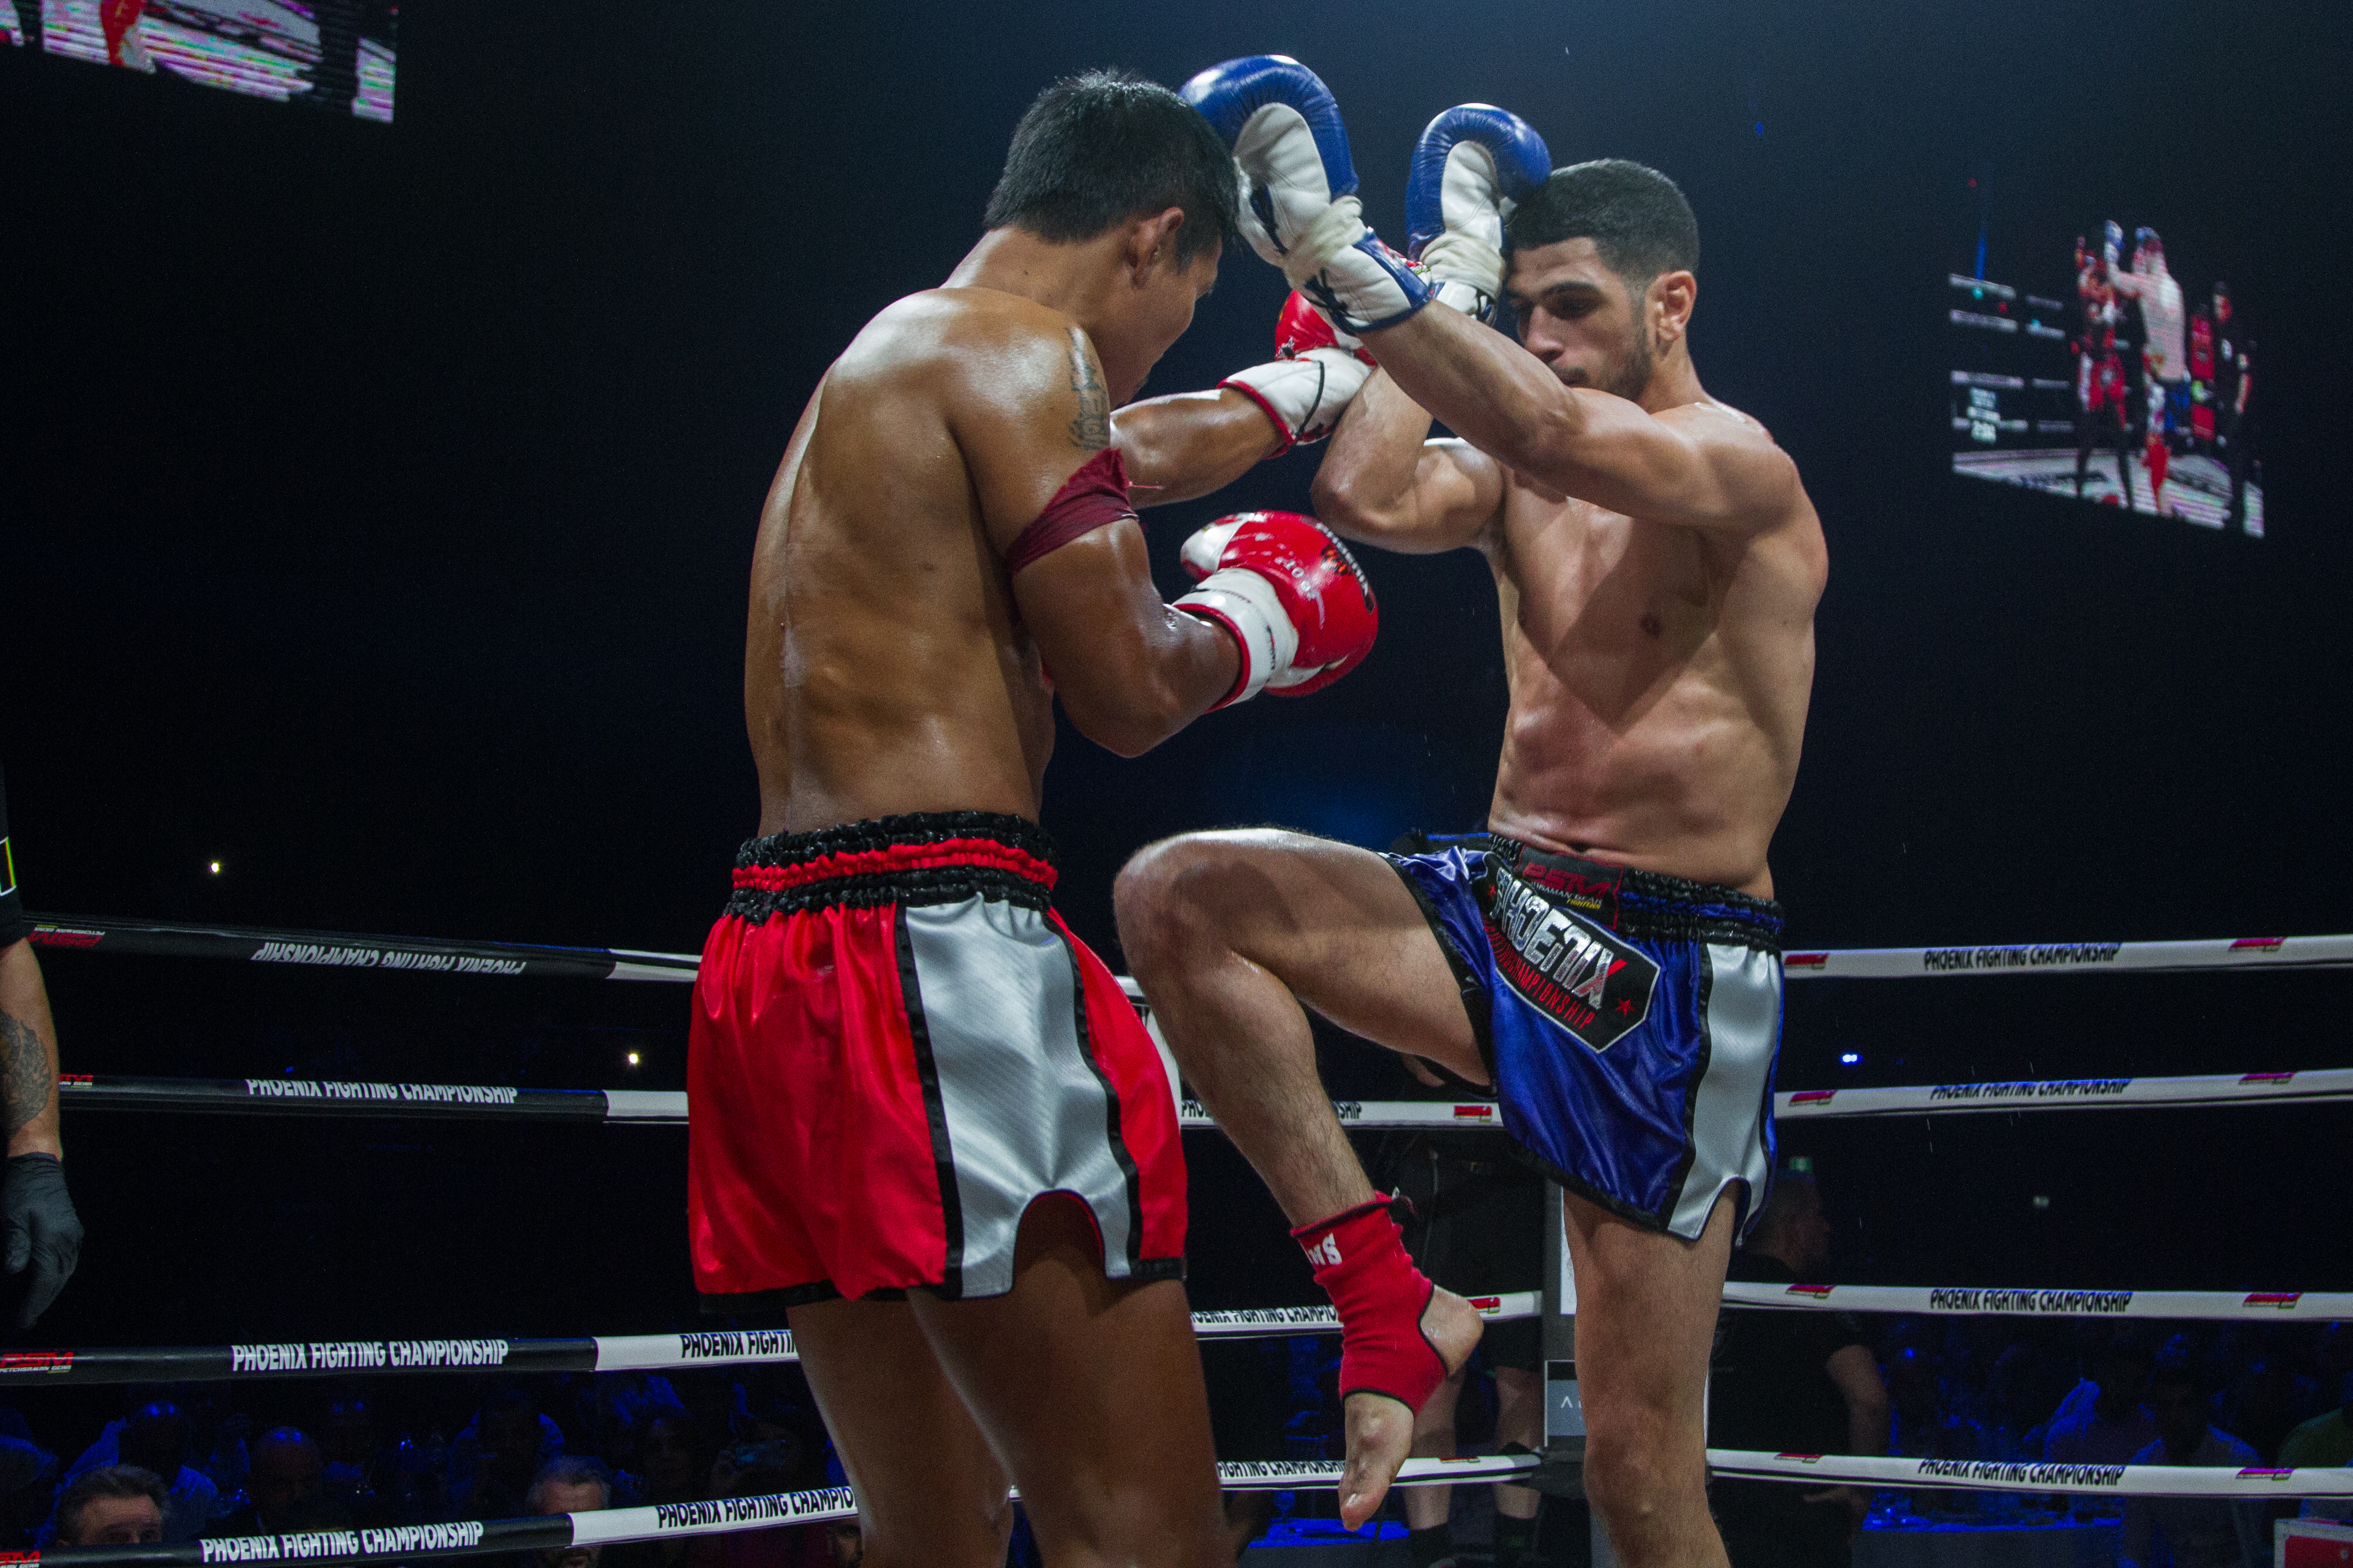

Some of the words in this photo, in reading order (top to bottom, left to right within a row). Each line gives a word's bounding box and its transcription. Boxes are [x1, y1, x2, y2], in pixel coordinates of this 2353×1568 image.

[250, 942, 380, 967] CHAMPIONSHIP
[379, 952, 455, 971] FIGHTING
[454, 957, 527, 974] PHOENIX
[1924, 949, 1973, 972] PHOENIX
[1975, 946, 2029, 969] FIGHTING
[2030, 943, 2122, 965] CHAMPIONSHIP
[244, 1079, 323, 1098] PHOENIX
[322, 1081, 399, 1100] FIGHTING
[399, 1083, 518, 1103] CHAMPIONSHIP
[1930, 1288, 1984, 1310] PHOENIX
[1983, 1289, 2038, 1311] FIGHTING
[2039, 1290, 2133, 1312] CHAMPIONSHIP
[1285, 1304, 1338, 1323] CHAMPIO
[231, 1344, 307, 1371] PHOENIX
[309, 1341, 386, 1369] FIGHTING
[388, 1339, 509, 1367] CHAMPIONSHIP
[680, 1332, 744, 1358] PHOENIX
[746, 1330, 797, 1355] FIGHTI
[1918, 1459, 1973, 1478] PHOENIX
[1973, 1461, 2029, 1483] FIGHTING
[2029, 1463, 2126, 1486] CHAMPIONSHIP
[656, 1500, 722, 1529] PHOENIX
[722, 1494, 789, 1522] FIGHTING
[790, 1487, 856, 1515] CHAMPIO
[200, 1535, 280, 1563] PHOENIX
[280, 1530, 359, 1559] FIGHTING
[360, 1521, 484, 1554] CHAMPIONSHIP
